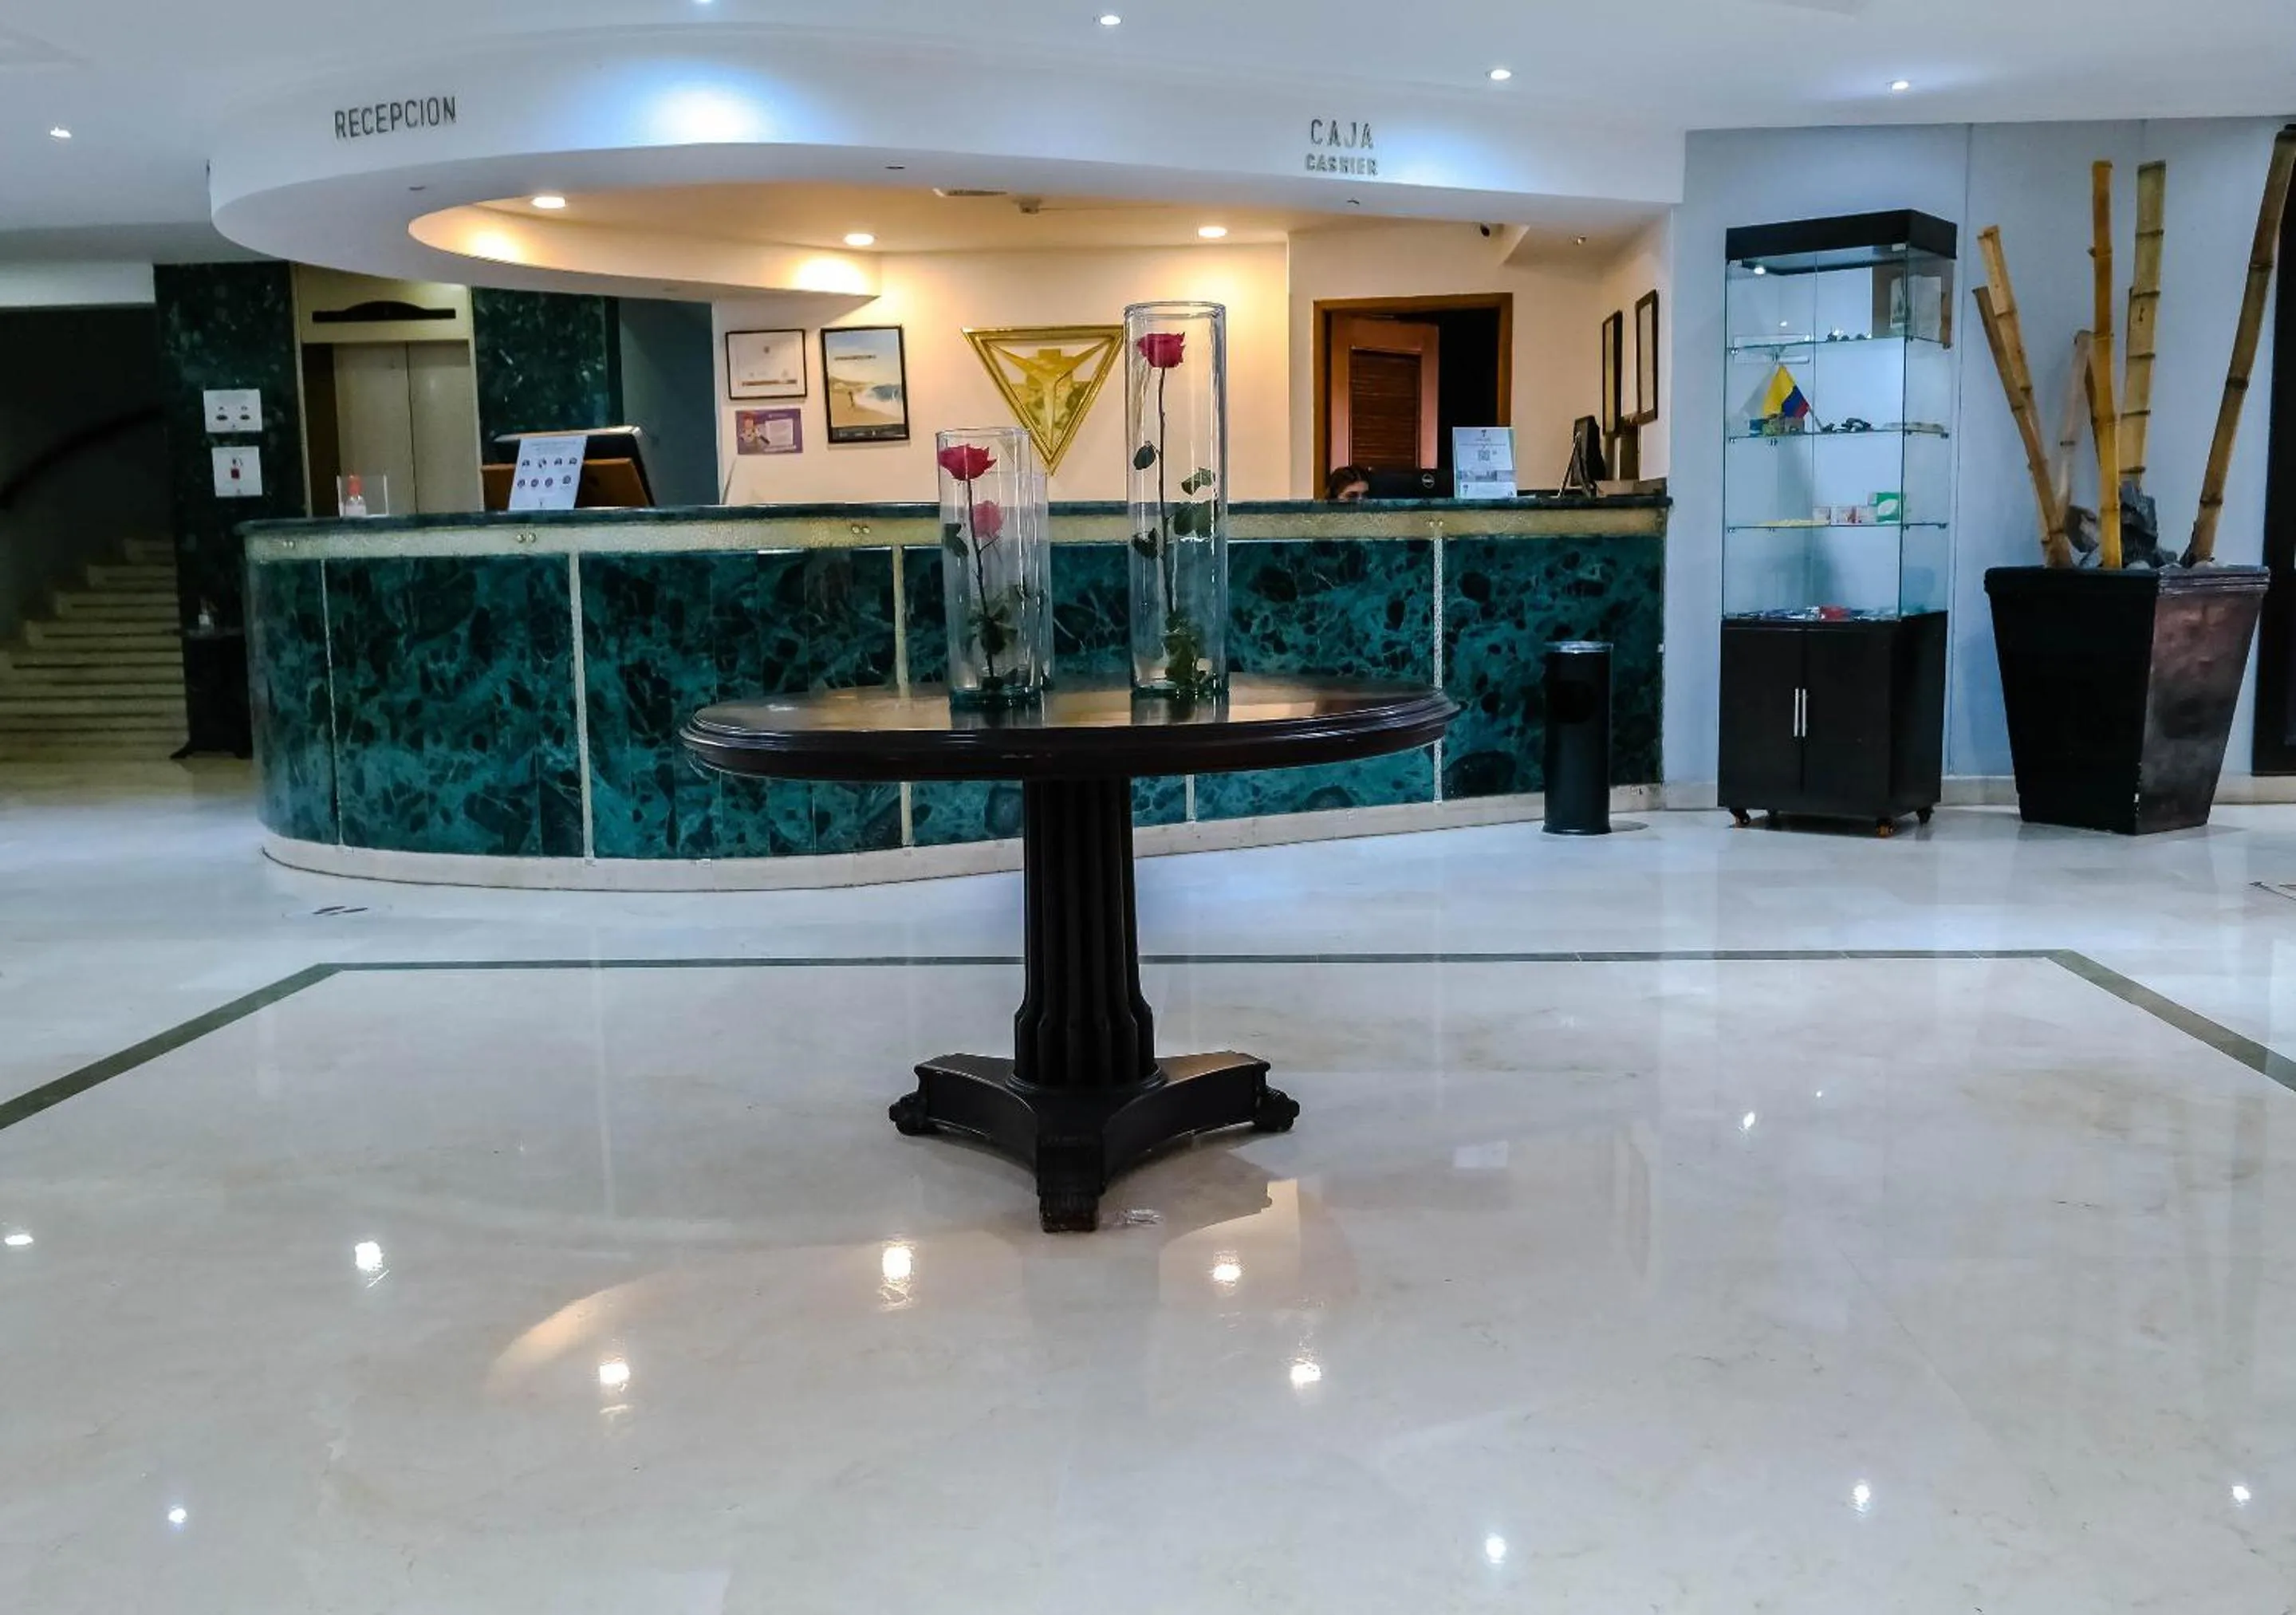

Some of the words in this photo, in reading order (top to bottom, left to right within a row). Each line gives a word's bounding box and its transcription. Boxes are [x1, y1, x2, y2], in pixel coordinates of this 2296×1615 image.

[334, 96, 457, 139] RECEPCION
[1310, 118, 1373, 149] CAJA
[1305, 153, 1378, 175] CASHIER
